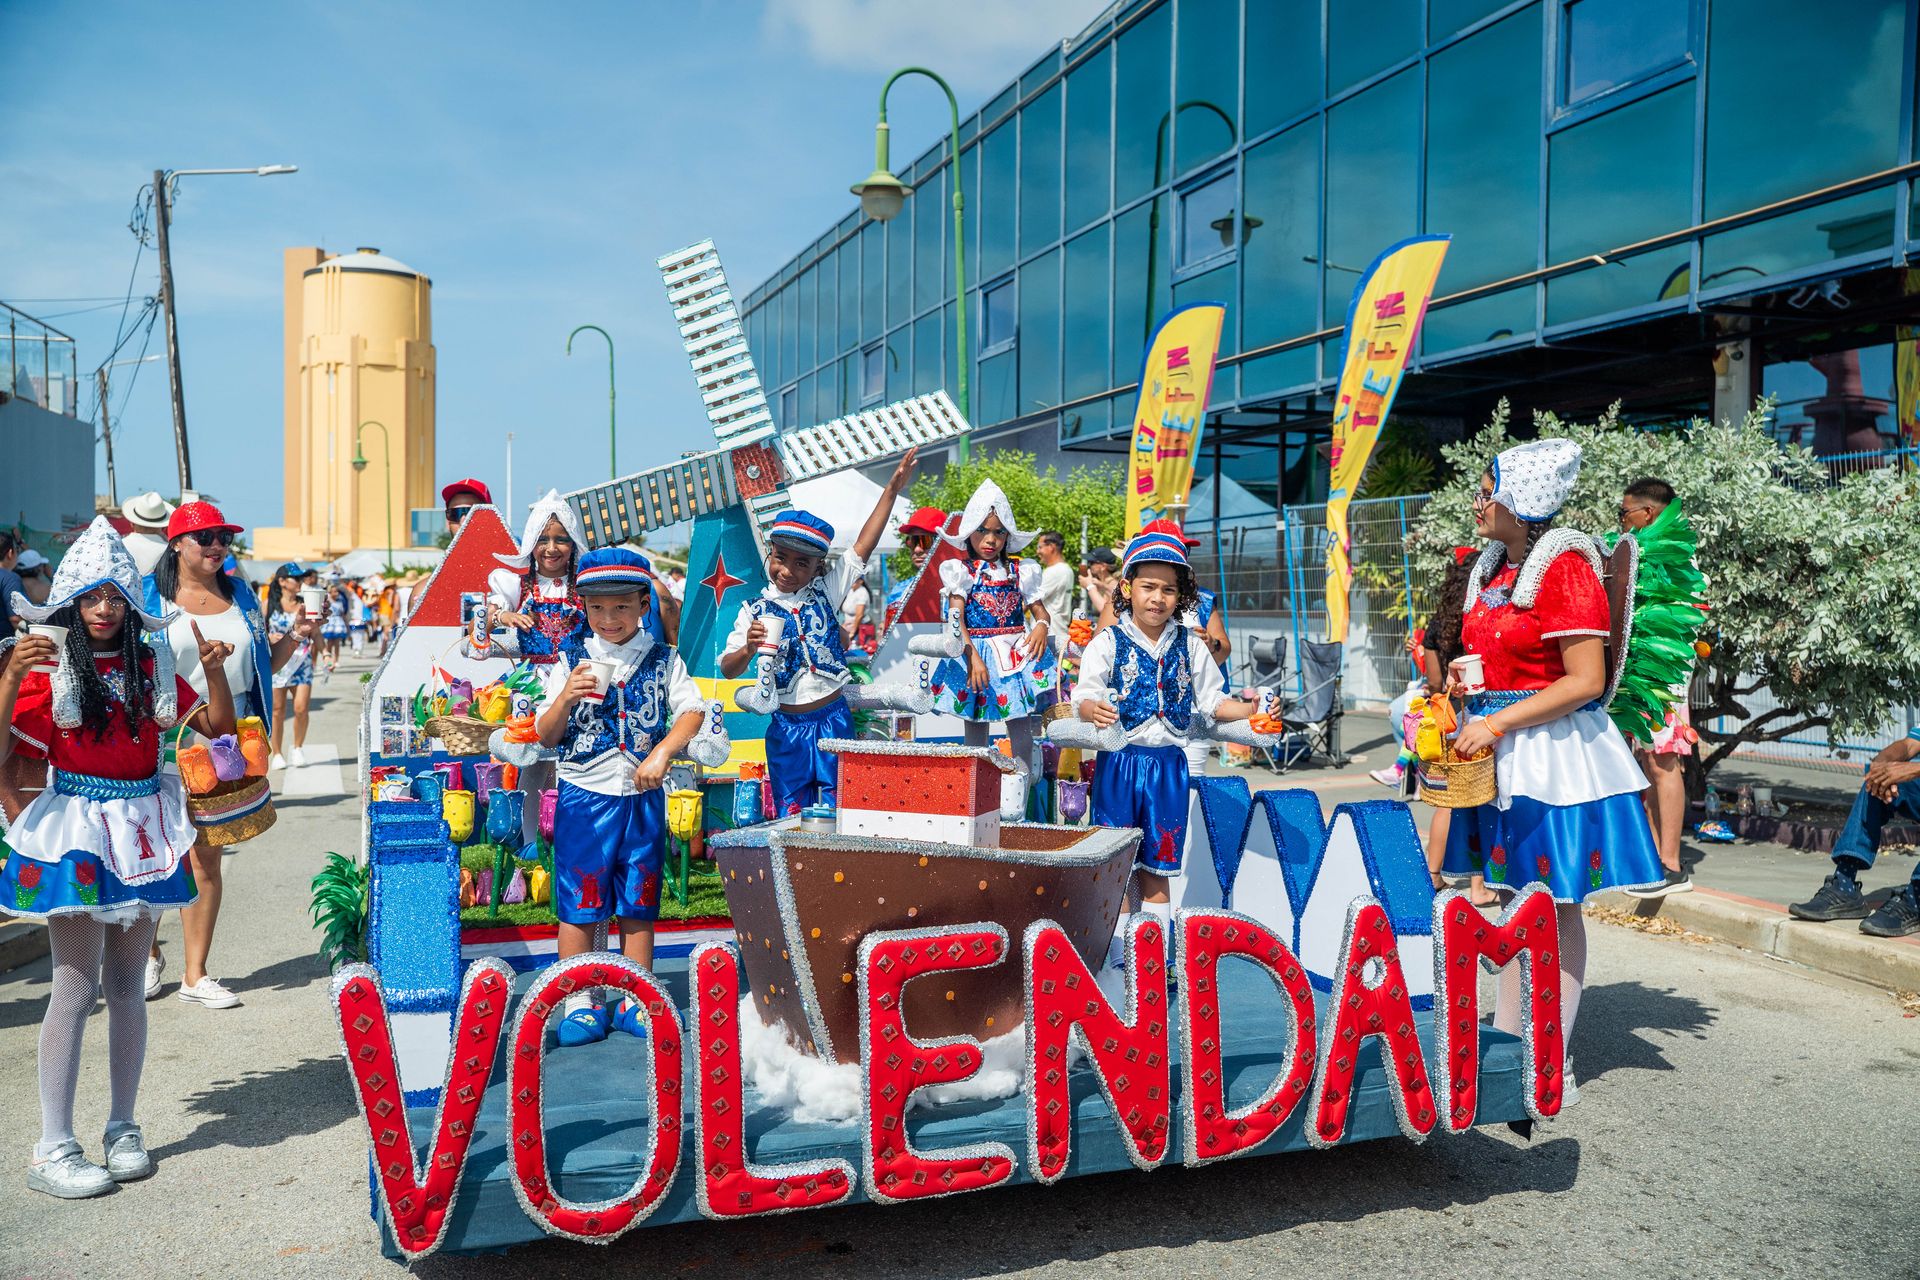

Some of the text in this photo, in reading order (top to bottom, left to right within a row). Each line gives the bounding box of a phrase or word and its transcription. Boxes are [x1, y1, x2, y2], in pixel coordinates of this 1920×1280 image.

[1369, 291, 1406, 362] FUN
[1157, 345, 1195, 463] THE FUN
[1351, 367, 1392, 432] THE
[1135, 419, 1168, 528] PROTECT
[332, 883, 1562, 1260] VOLENDAM
